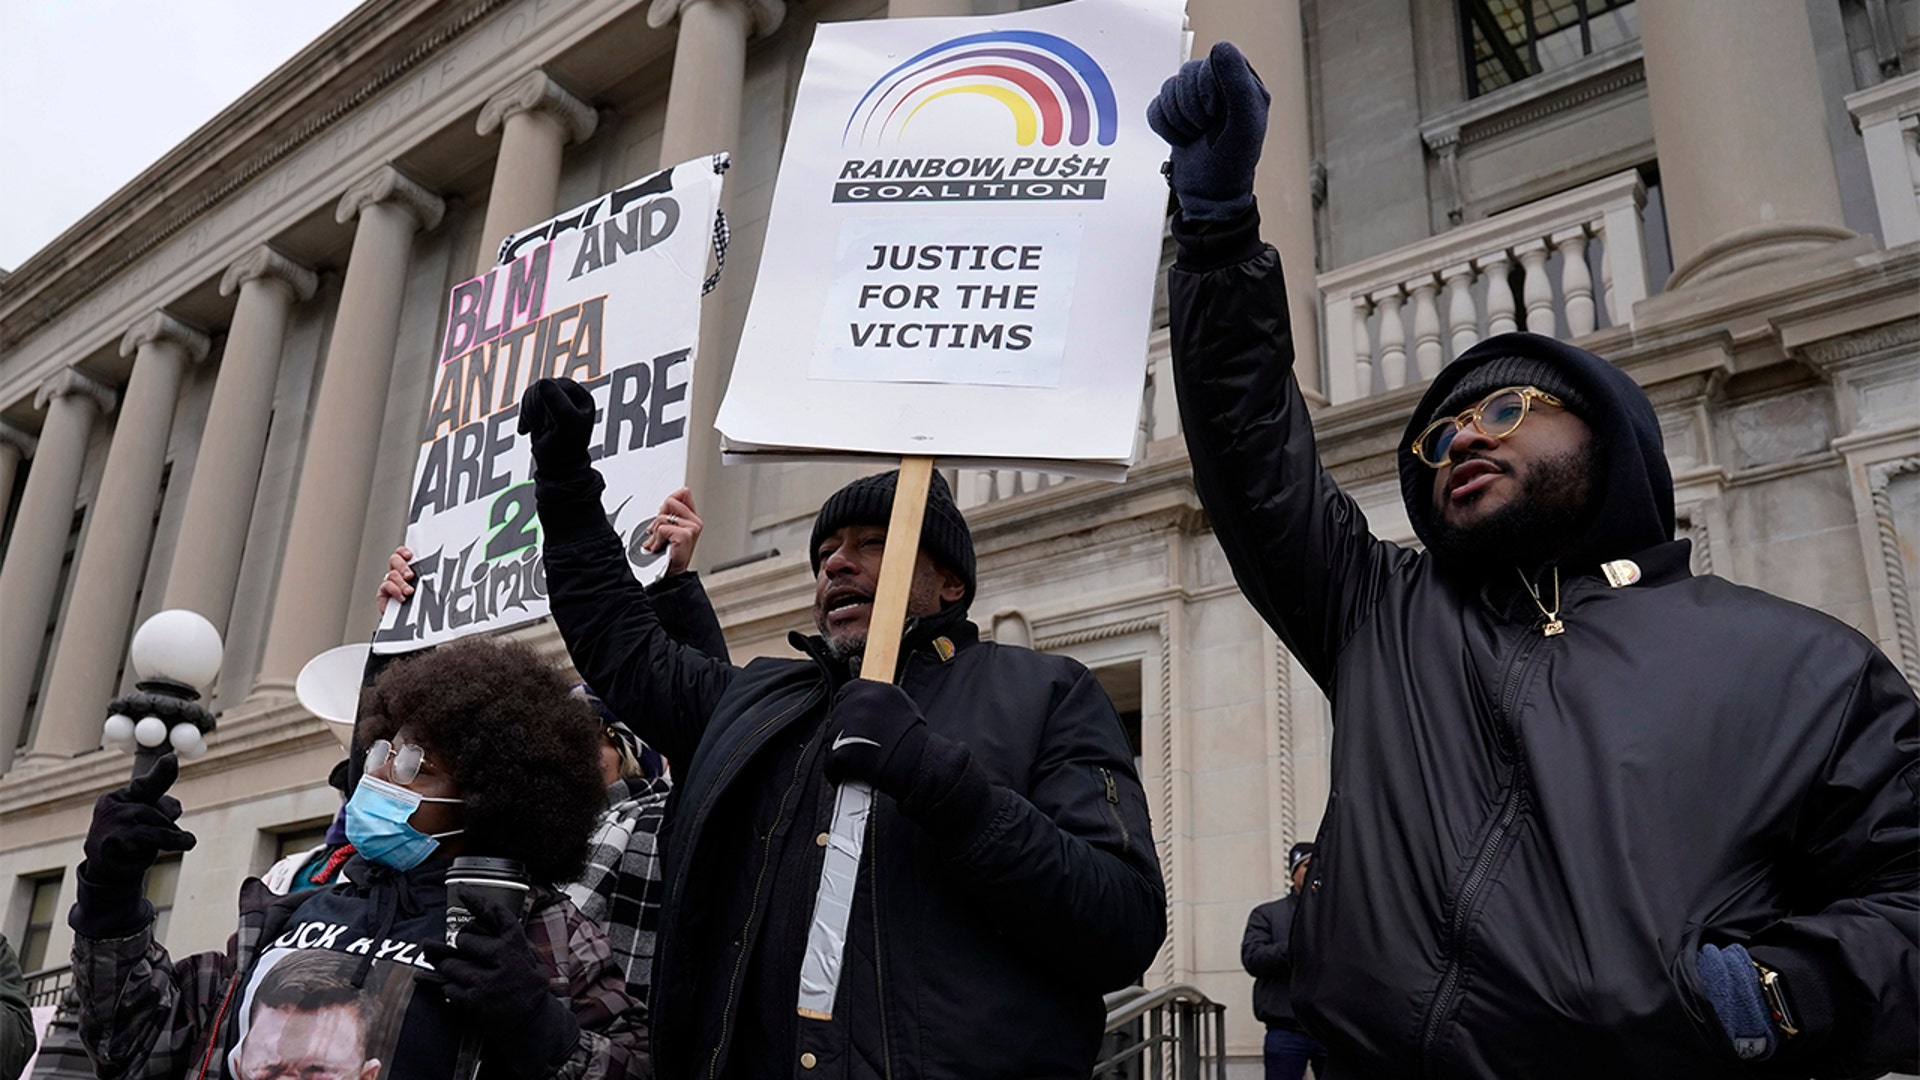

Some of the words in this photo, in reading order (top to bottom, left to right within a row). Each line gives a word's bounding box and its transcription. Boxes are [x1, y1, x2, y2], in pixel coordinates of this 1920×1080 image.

[333, 55, 456, 158] PEOPLE
[502, 1, 549, 46] OF
[839, 157, 1004, 180] RAINBOW
[846, 183, 1086, 199] COALITION
[568, 197, 681, 281] AND
[866, 245, 1043, 271] JUSTICE
[443, 239, 555, 364] BLM
[858, 284, 940, 309] FOR
[956, 284, 1039, 310] THE
[850, 322, 1034, 350] VICTIMS
[423, 295, 609, 444] ANTIFA
[410, 401, 520, 525] ARE
[486, 479, 540, 562] 2
[262, 921, 348, 953] UCK
